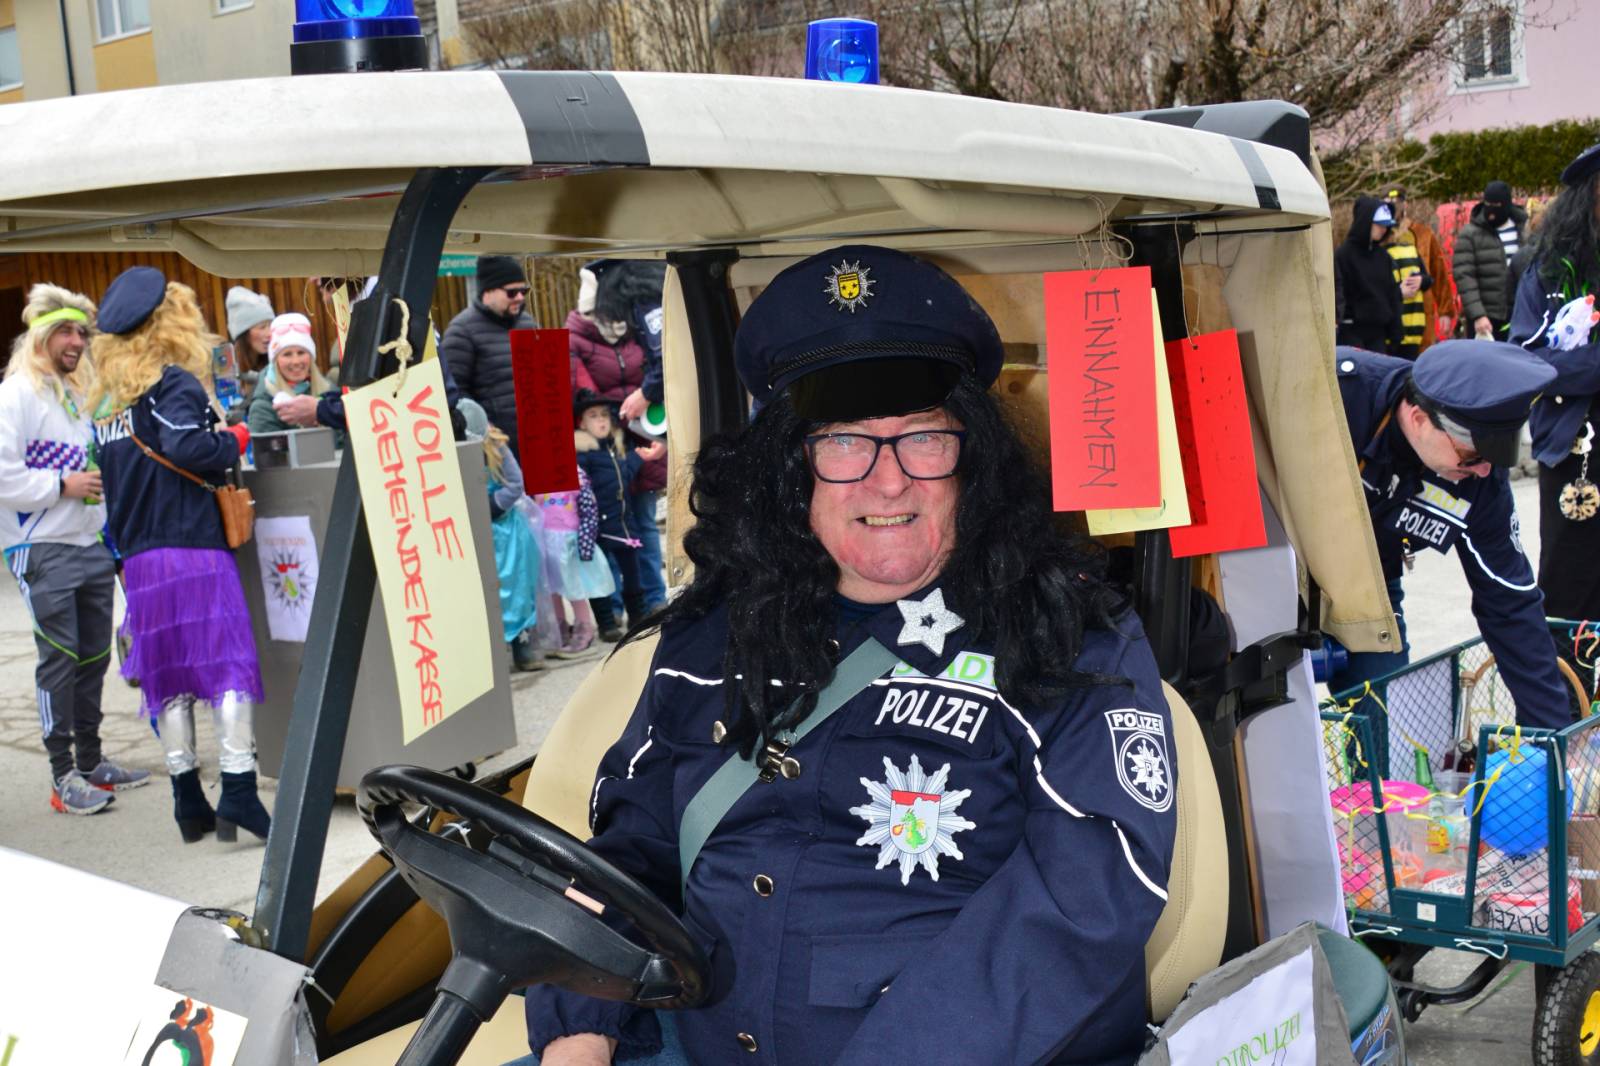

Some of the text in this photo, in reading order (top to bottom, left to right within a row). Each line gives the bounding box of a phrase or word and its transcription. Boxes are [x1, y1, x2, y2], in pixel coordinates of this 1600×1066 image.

[97, 408, 135, 446] OLIZEI
[406, 385, 464, 561] VOLLE
[1395, 507, 1450, 546] POLIZEI
[874, 688, 989, 744] POLIZEI
[1111, 713, 1163, 732] POLIZEI
